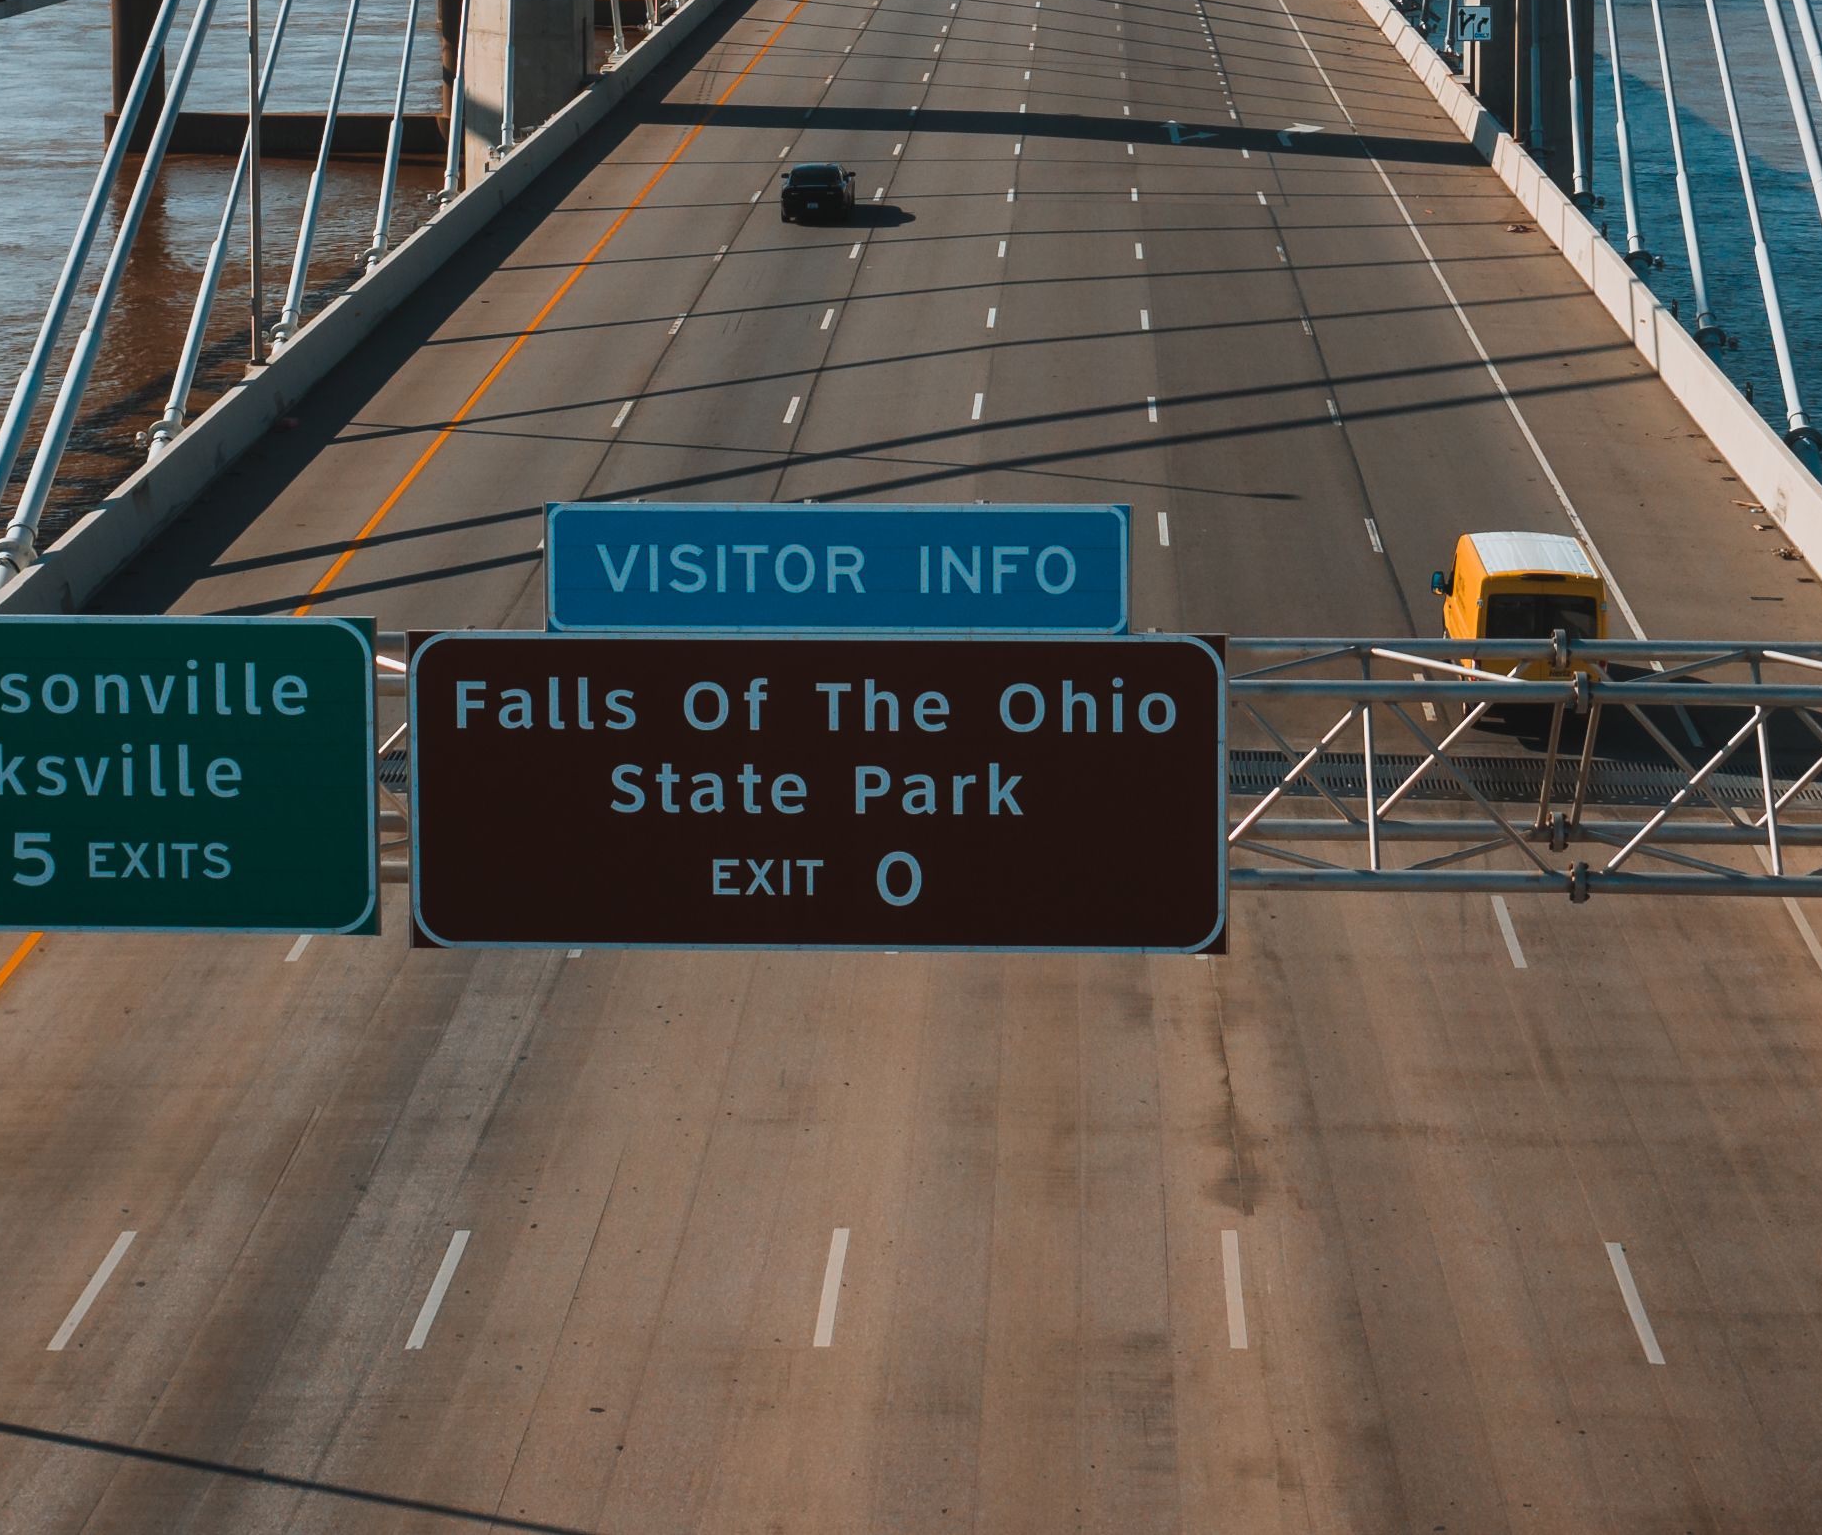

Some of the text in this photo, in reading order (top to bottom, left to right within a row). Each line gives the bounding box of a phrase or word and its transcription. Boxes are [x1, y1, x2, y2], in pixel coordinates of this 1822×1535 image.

[597, 544, 1076, 594] VISITOR INFO
[457, 677, 1176, 733] Falls Of The Ohio
[611, 763, 1023, 815] State Park
[13, 833, 55, 886] 5
[89, 843, 230, 879] EXITS
[713, 851, 921, 906] EXIT 0
